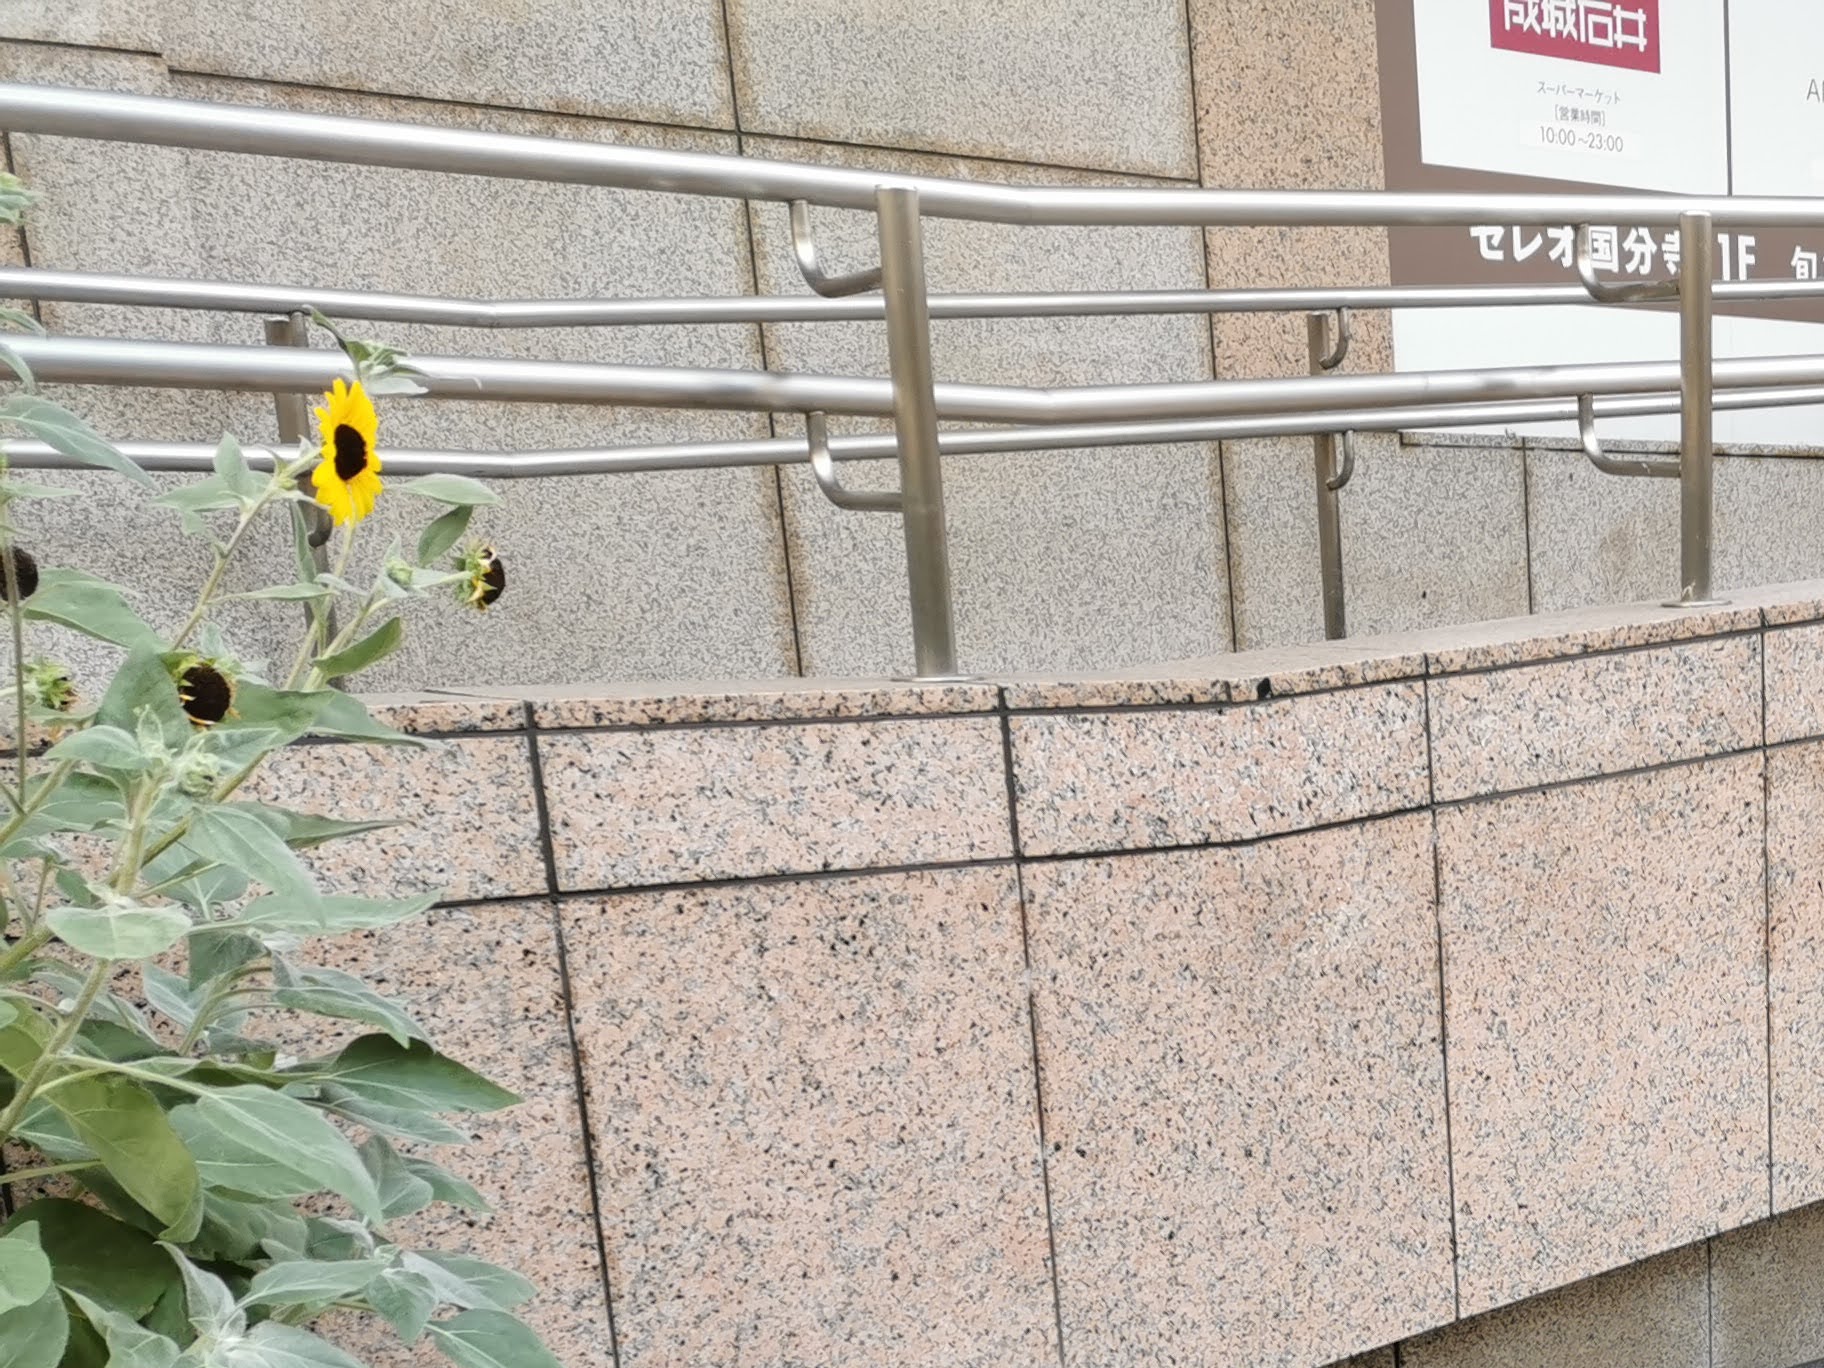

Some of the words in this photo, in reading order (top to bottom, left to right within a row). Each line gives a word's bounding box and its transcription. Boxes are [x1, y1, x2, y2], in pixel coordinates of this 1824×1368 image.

[1537, 80, 1621, 105] スーパーマーケット
[1716, 232, 1756, 281] 1F
